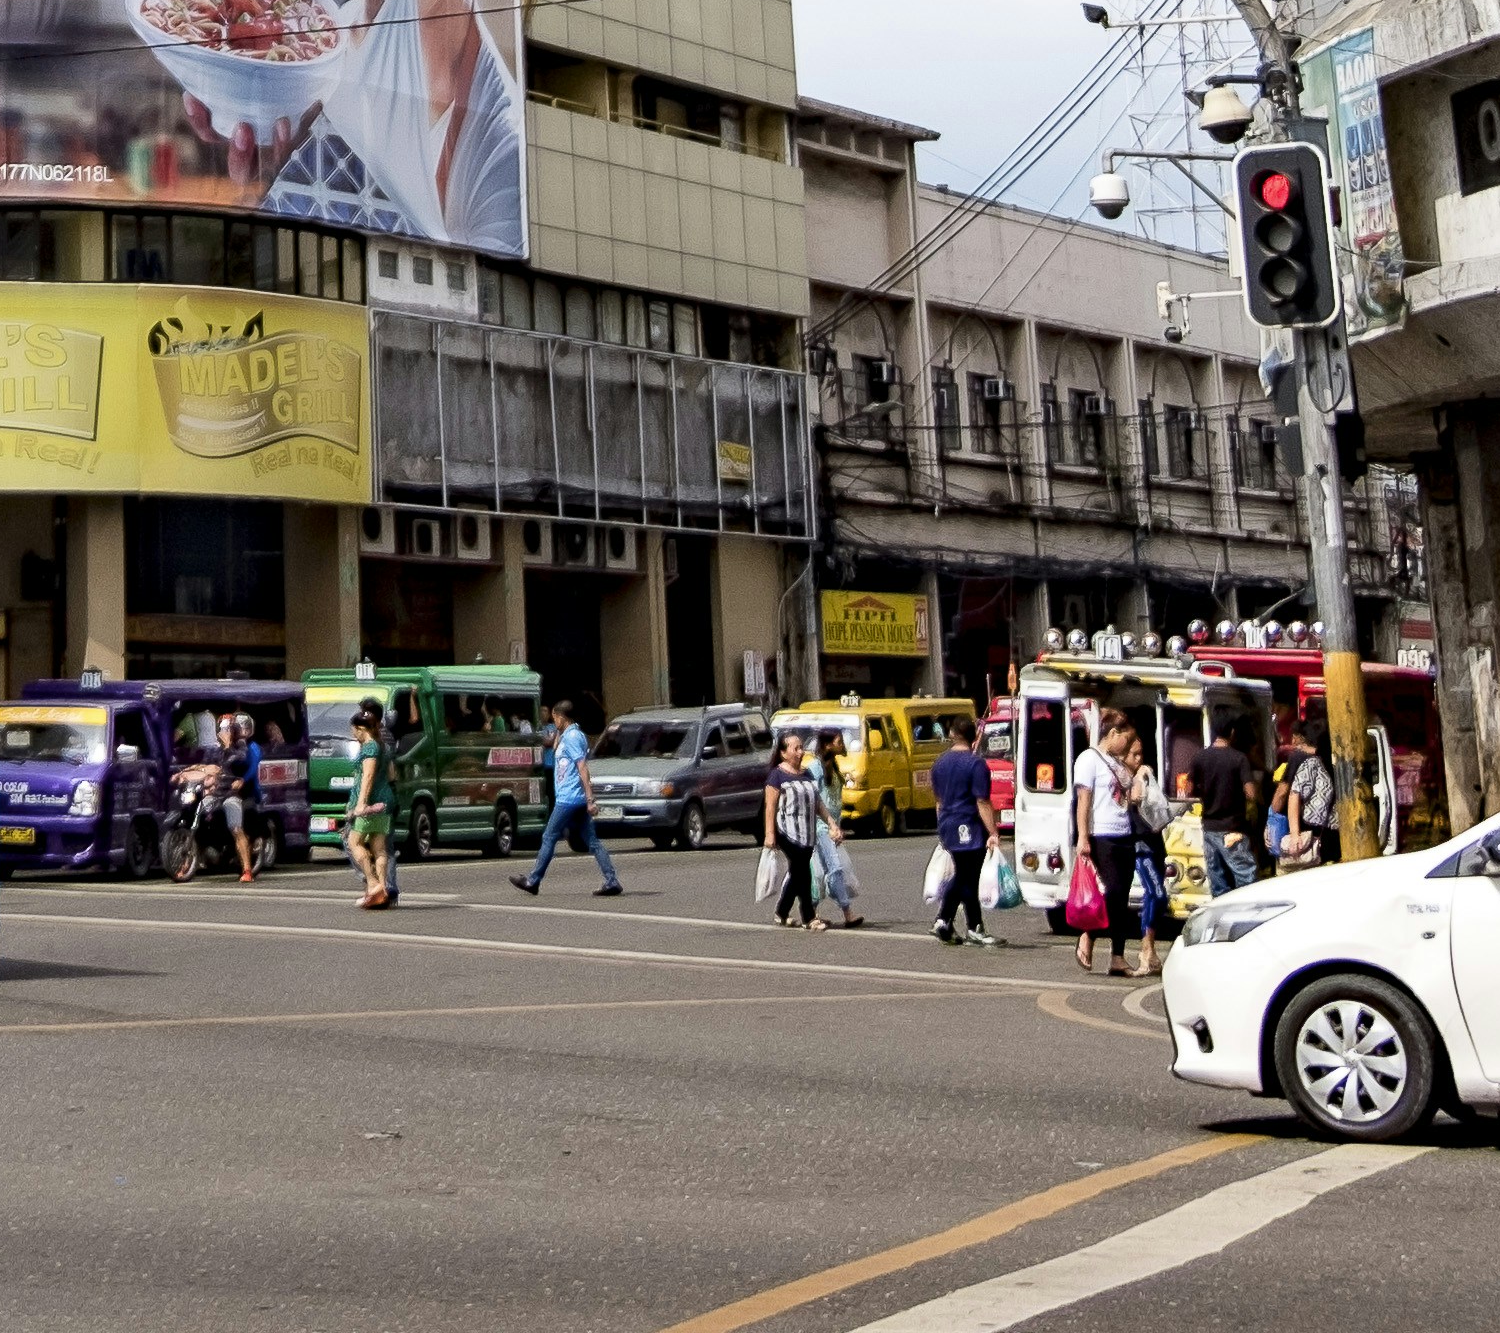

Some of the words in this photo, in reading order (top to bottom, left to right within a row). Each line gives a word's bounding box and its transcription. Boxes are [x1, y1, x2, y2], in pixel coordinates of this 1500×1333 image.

[179, 338, 346, 398] MADEL'S
[271, 388, 356, 426] GRILL
[14, 431, 104, 475] Real!
